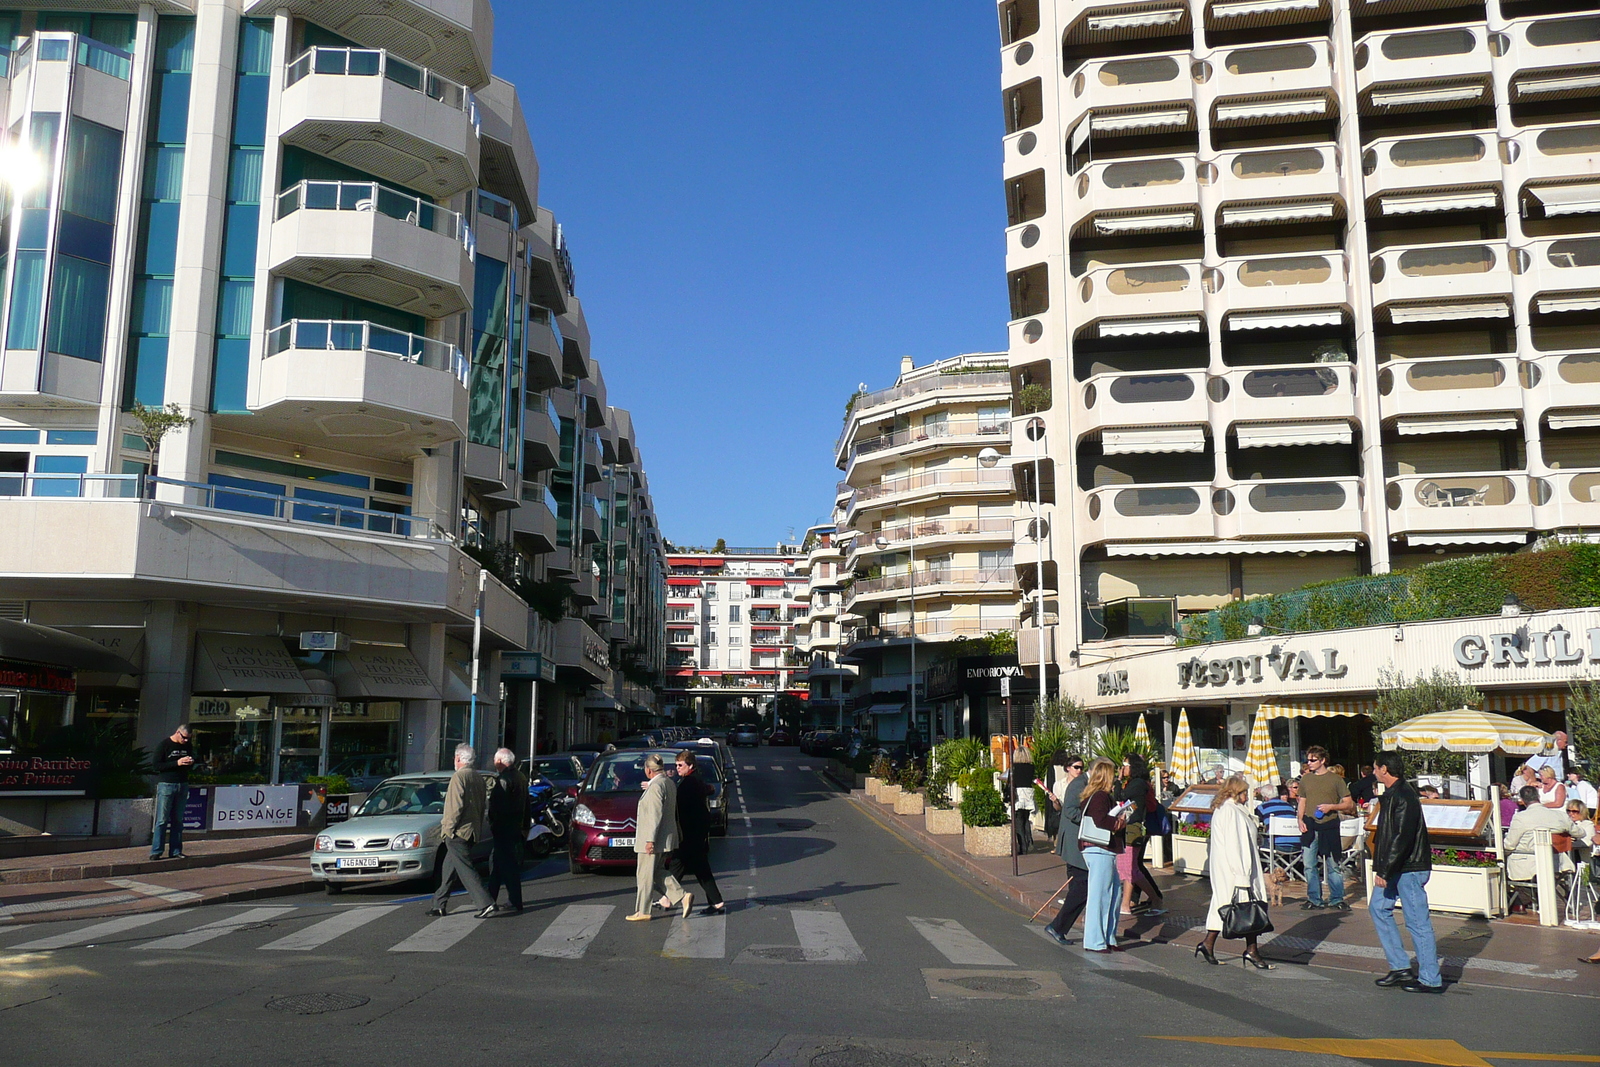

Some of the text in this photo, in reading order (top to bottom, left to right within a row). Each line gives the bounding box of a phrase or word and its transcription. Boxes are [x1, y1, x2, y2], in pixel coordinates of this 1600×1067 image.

[221, 646, 290, 658] CAVIAR
[226, 656, 295, 668] HOUSE
[360, 655, 417, 666] CAVIAR
[232, 668, 301, 680] PRUNIER
[365, 664, 424, 676] HOUSE
[966, 666, 1002, 678] EMPORIO
[1177, 648, 1348, 689] FESTIVAL
[373, 676, 432, 687] PRUNIER
[1097, 670, 1129, 696] BAR
[30, 756, 91, 770] Barrière
[22, 772, 76, 785] Princes
[218, 808, 293, 822] DESSANGE
